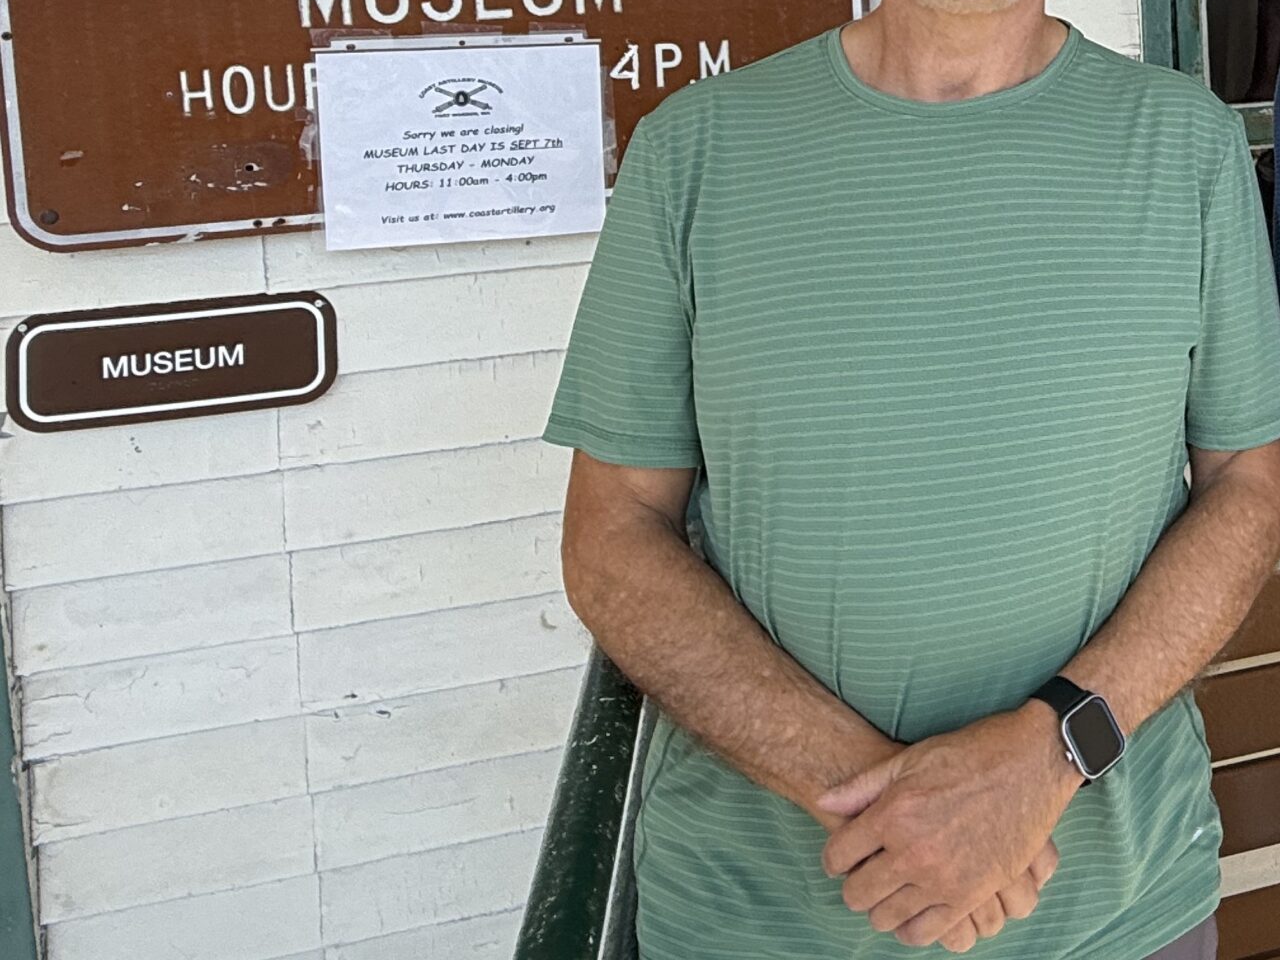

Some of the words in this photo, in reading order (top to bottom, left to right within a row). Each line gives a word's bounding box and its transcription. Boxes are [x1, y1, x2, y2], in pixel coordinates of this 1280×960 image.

[402, 130, 436, 141] Sorry
[440, 130, 456, 138] we
[460, 128, 479, 137] are
[483, 124, 524, 135] closing!
[363, 146, 419, 159] MUSEUM
[423, 144, 456, 156] LAST
[460, 142, 486, 153] DAY
[490, 141, 506, 152] IS
[509, 139, 539, 150] SEPT
[543, 137, 564, 149] 7th
[397, 161, 465, 174] THURSDAY
[480, 156, 535, 169] MONDAY
[385, 179, 434, 192] HOURS:
[439, 176, 489, 188] 11:00am
[505, 172, 548, 184] 4:00pm
[381, 215, 405, 225] Visit
[423, 212, 440, 222] at:
[443, 203, 556, 220] www.coastartillery.org
[102, 343, 245, 379] MUSEUM
